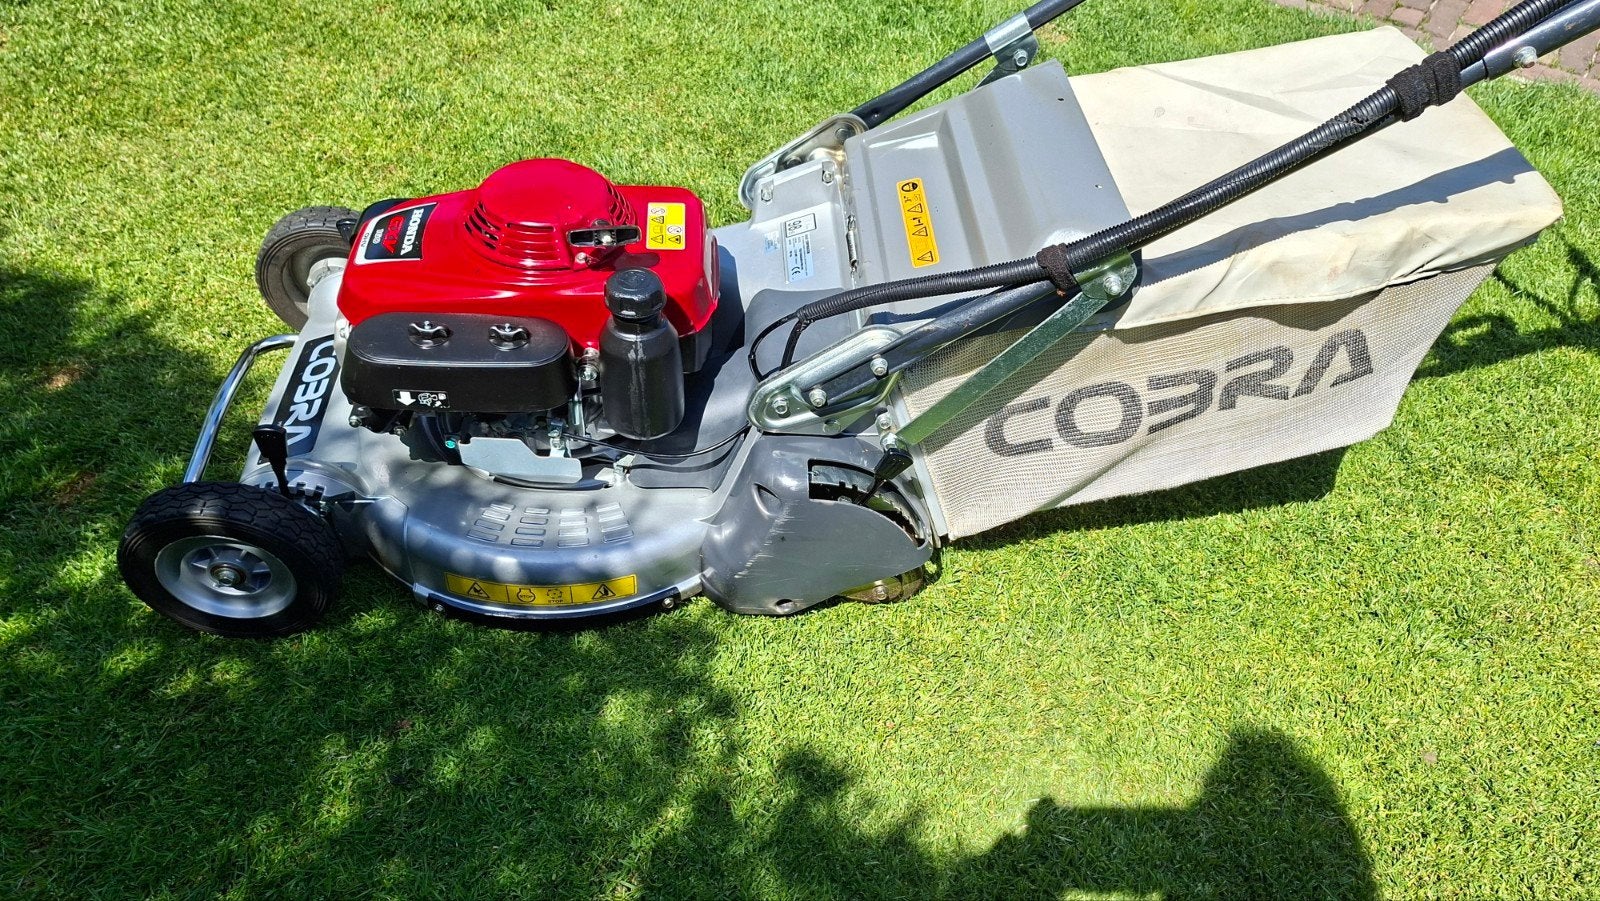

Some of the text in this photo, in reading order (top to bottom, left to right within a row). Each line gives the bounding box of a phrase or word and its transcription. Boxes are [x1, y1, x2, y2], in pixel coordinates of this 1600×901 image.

[382, 215, 405, 254] GXV
[400, 208, 424, 255] HONDA
[985, 328, 1373, 457] COBRA
